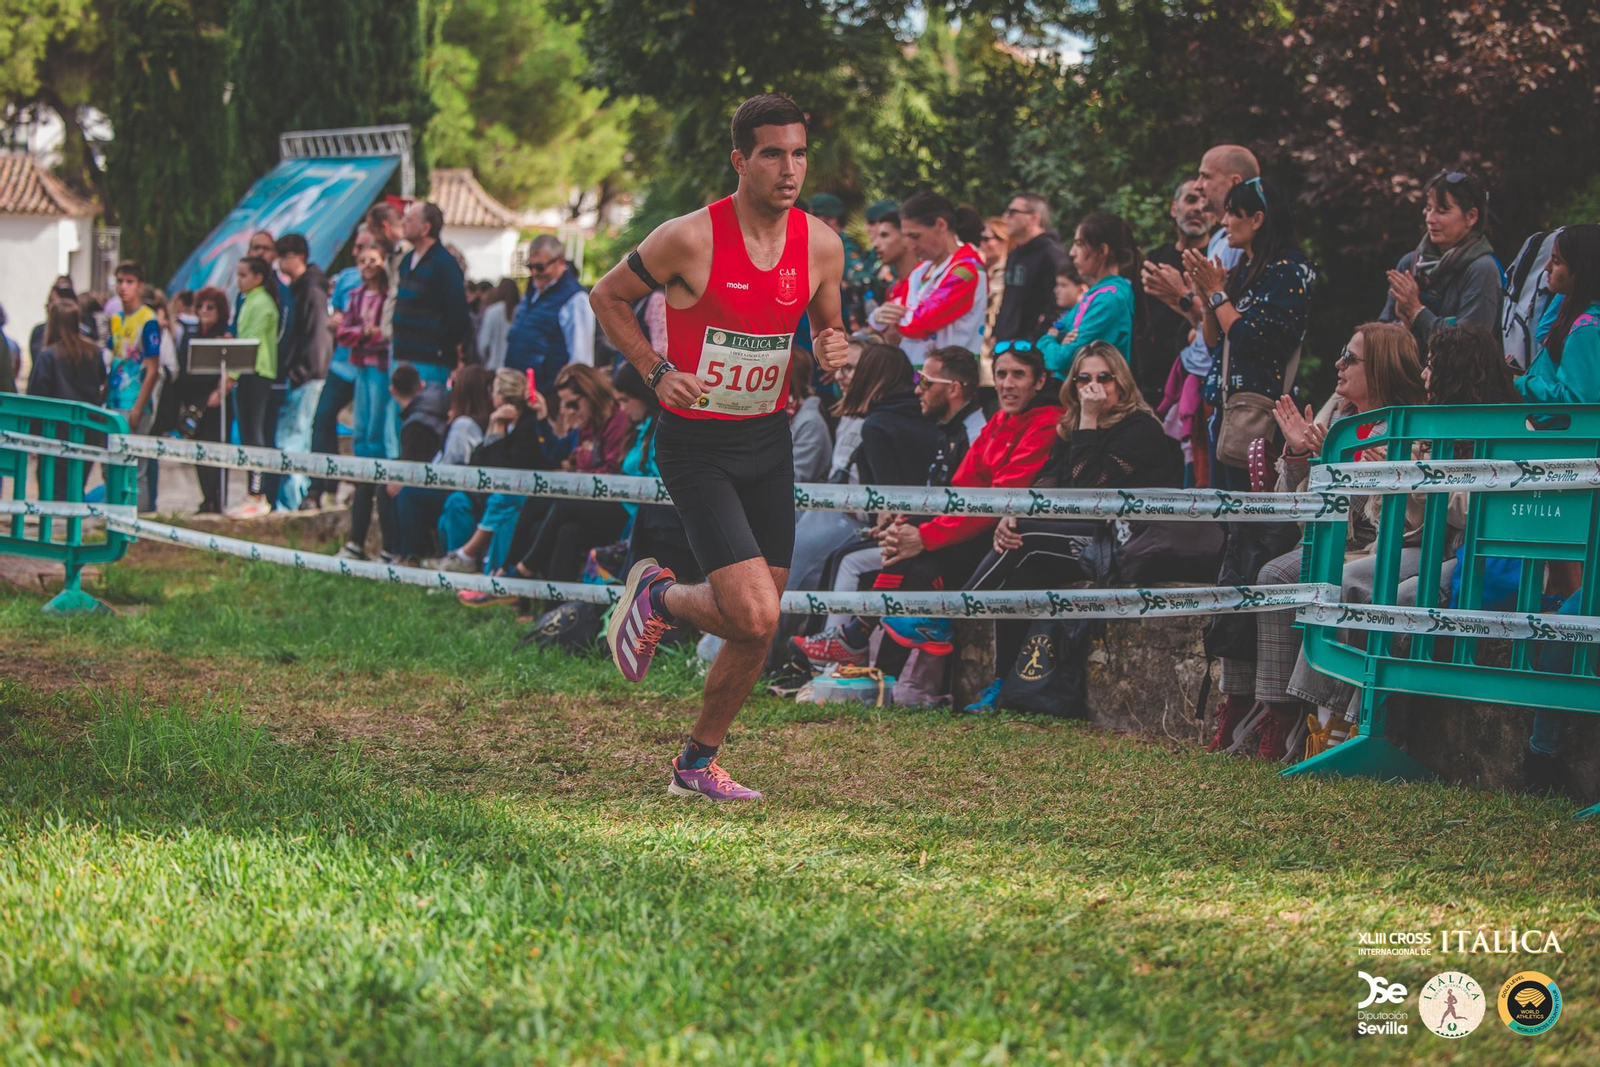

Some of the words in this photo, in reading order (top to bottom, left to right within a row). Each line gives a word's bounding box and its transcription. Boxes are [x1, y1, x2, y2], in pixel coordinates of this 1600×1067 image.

[726, 282, 748, 290] mobel
[732, 336, 771, 349] ITÁLICA
[704, 360, 779, 392] 5109
[1445, 474, 1477, 484] Sevilla
[1545, 470, 1580, 482] Sevilla
[811, 499, 834, 508] Sevilla
[887, 501, 911, 512] Sevilla
[967, 502, 993, 514] Sevilla
[1052, 504, 1080, 515] Sevilla
[1145, 504, 1174, 515] Sevilla
[1244, 504, 1275, 515] Sevilla
[1512, 504, 1561, 517] SEVILLA
[1170, 598, 1200, 610] Sevilla
[1264, 596, 1296, 606] Sevilla
[988, 606, 1015, 614] Sevilla
[1074, 602, 1106, 612] Sevilla
[1366, 612, 1394, 625] Sevilla
[1460, 623, 1490, 635] Sevilla
[1560, 630, 1593, 641] Sevilla
